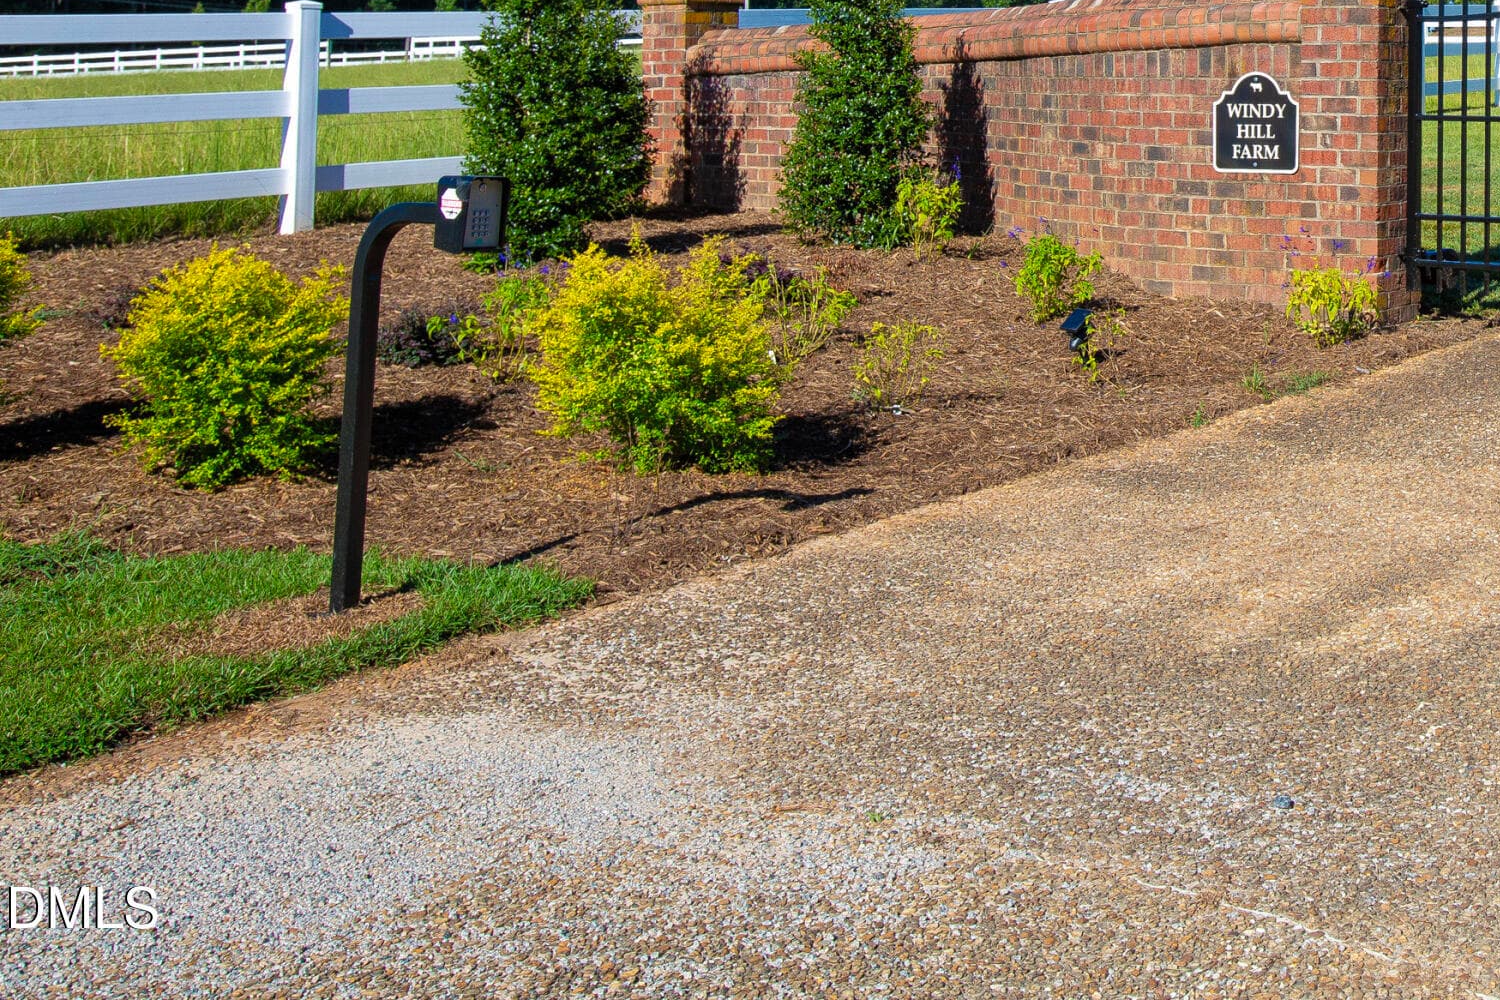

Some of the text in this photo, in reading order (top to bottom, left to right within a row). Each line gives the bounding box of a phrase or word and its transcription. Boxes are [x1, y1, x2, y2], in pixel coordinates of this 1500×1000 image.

[1226, 103, 1286, 119] WINDY
[1236, 124, 1276, 139] HILL
[1232, 144, 1280, 160] FARM
